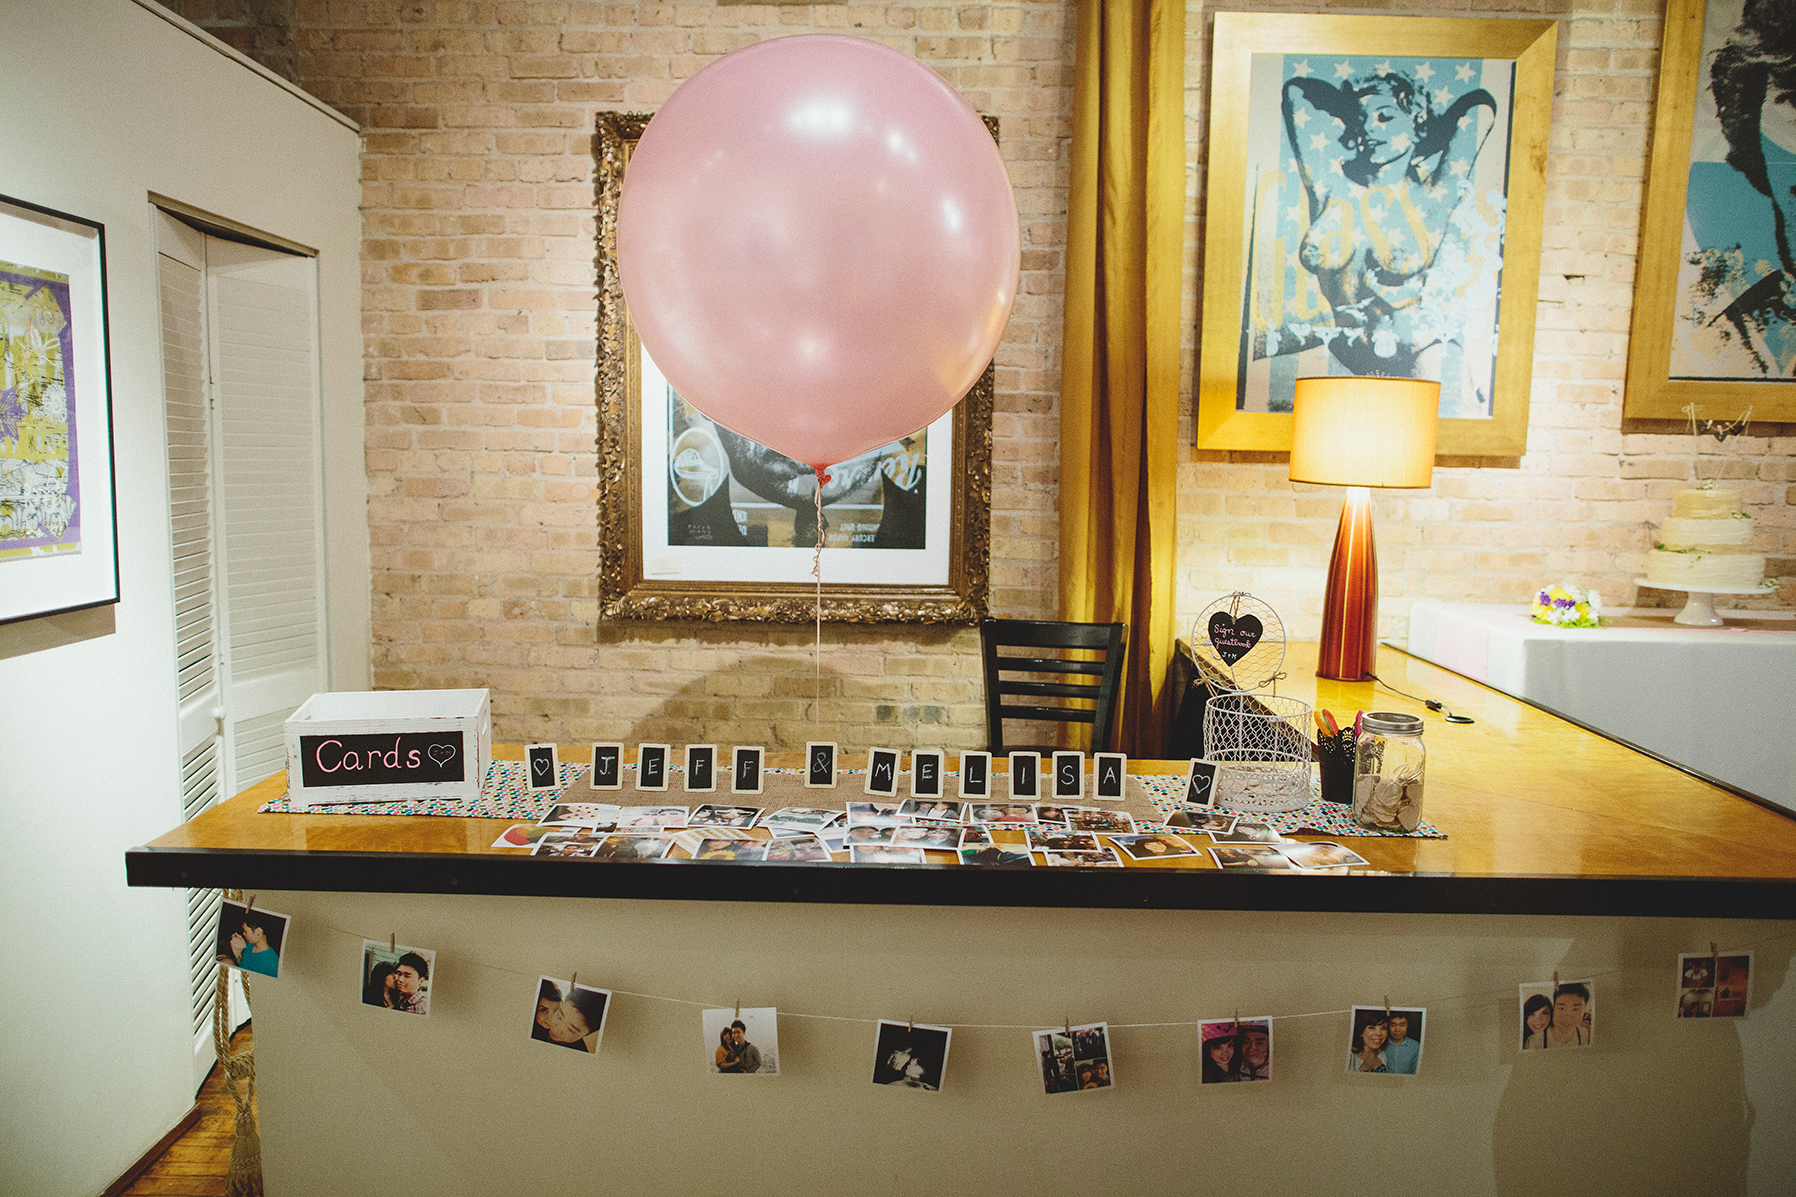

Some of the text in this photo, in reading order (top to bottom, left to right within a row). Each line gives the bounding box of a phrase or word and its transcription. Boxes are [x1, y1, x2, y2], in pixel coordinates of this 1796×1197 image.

[1213, 623, 1257, 638] Sign our
[316, 736, 421, 773] Cards
